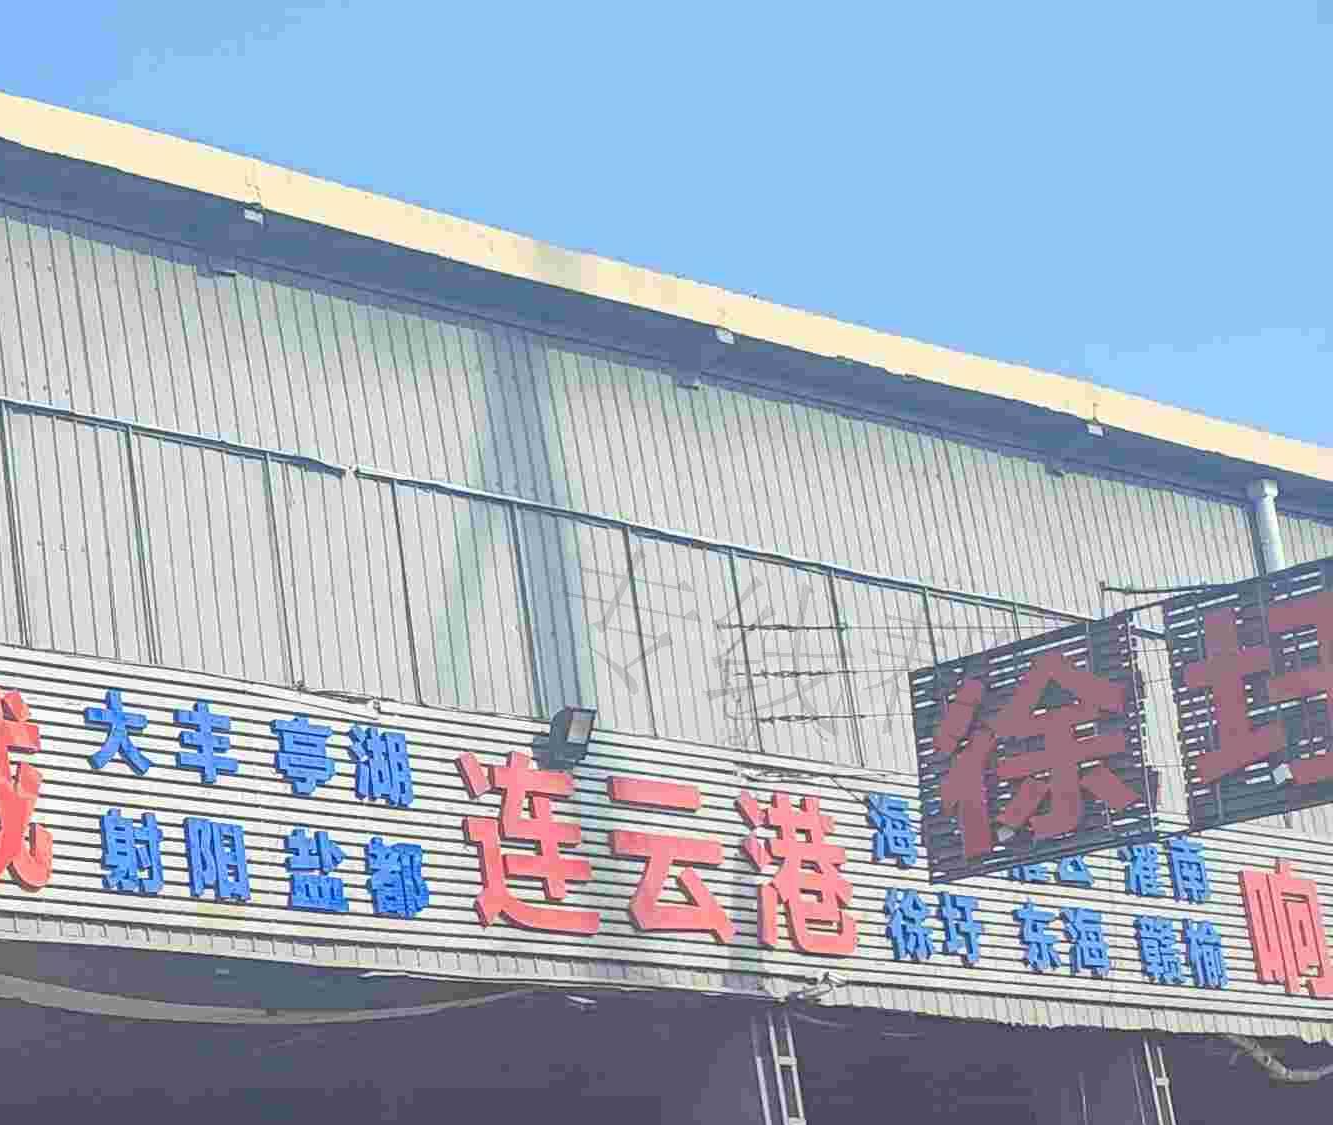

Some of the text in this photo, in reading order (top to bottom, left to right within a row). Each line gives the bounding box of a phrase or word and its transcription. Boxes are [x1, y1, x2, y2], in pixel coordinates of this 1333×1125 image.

[83, 689, 415, 808] 大丰 亭湖
[100, 808, 431, 919] 射阳 盐都
[456, 750, 858, 958] 连云港
[1118, 837, 1215, 904] 灌南
[1013, 895, 1112, 978] 东海
[1238, 855, 1333, 1000] 响
